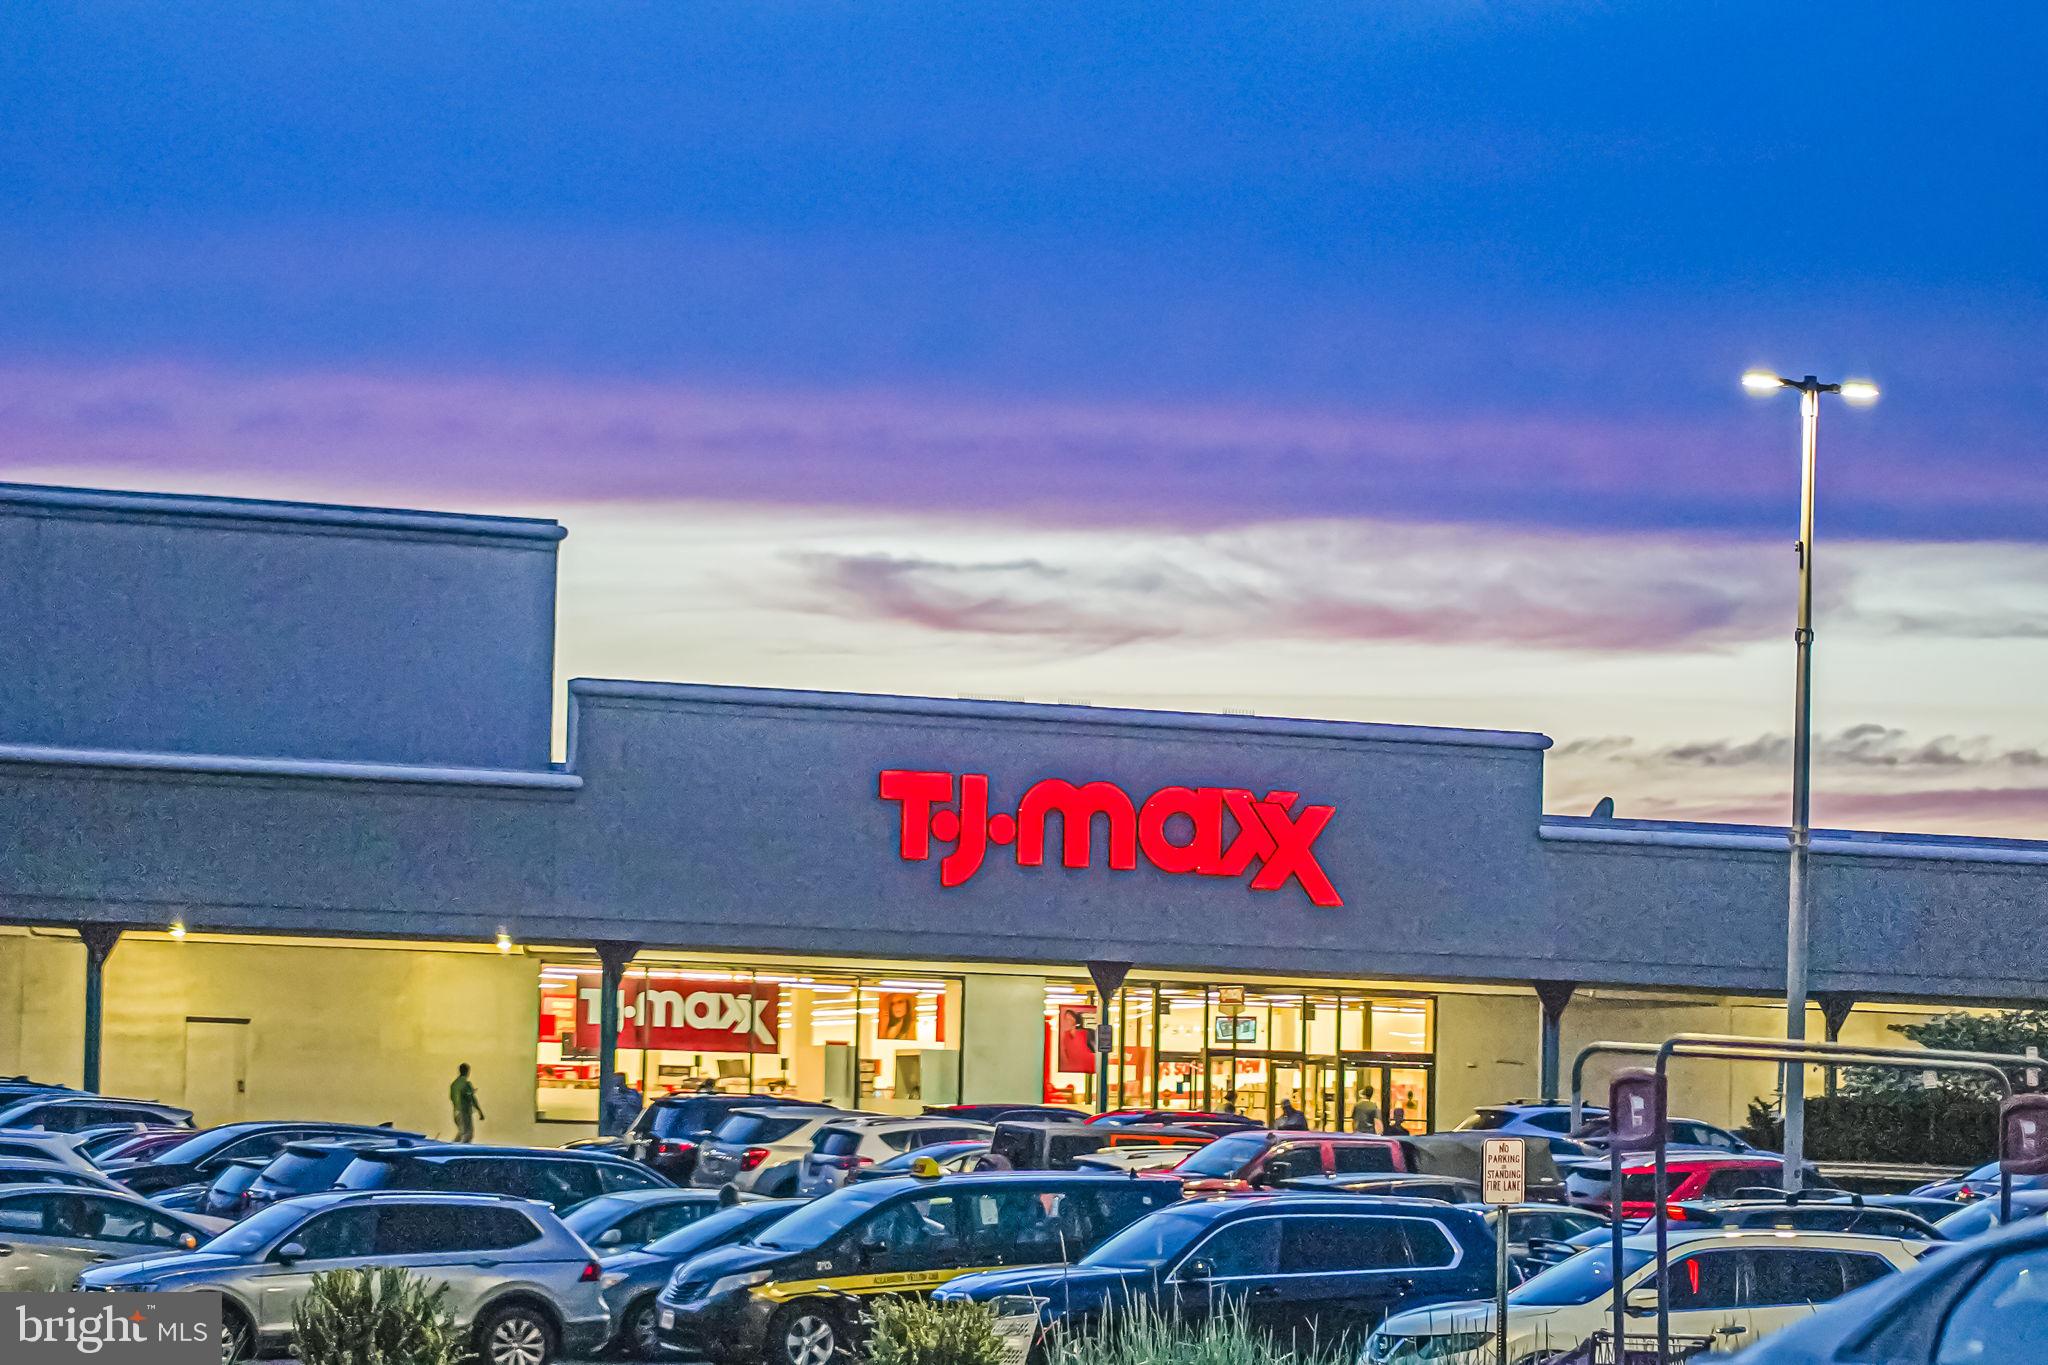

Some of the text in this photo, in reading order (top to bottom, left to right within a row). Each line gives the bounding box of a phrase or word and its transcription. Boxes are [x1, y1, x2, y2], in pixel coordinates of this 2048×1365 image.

[1499, 1143, 1509, 1153] NO
[1488, 1155, 1520, 1163] PARKING
[1487, 1170, 1521, 1179] STANDING
[1487, 1181, 1521, 1191] FIRE LANE
